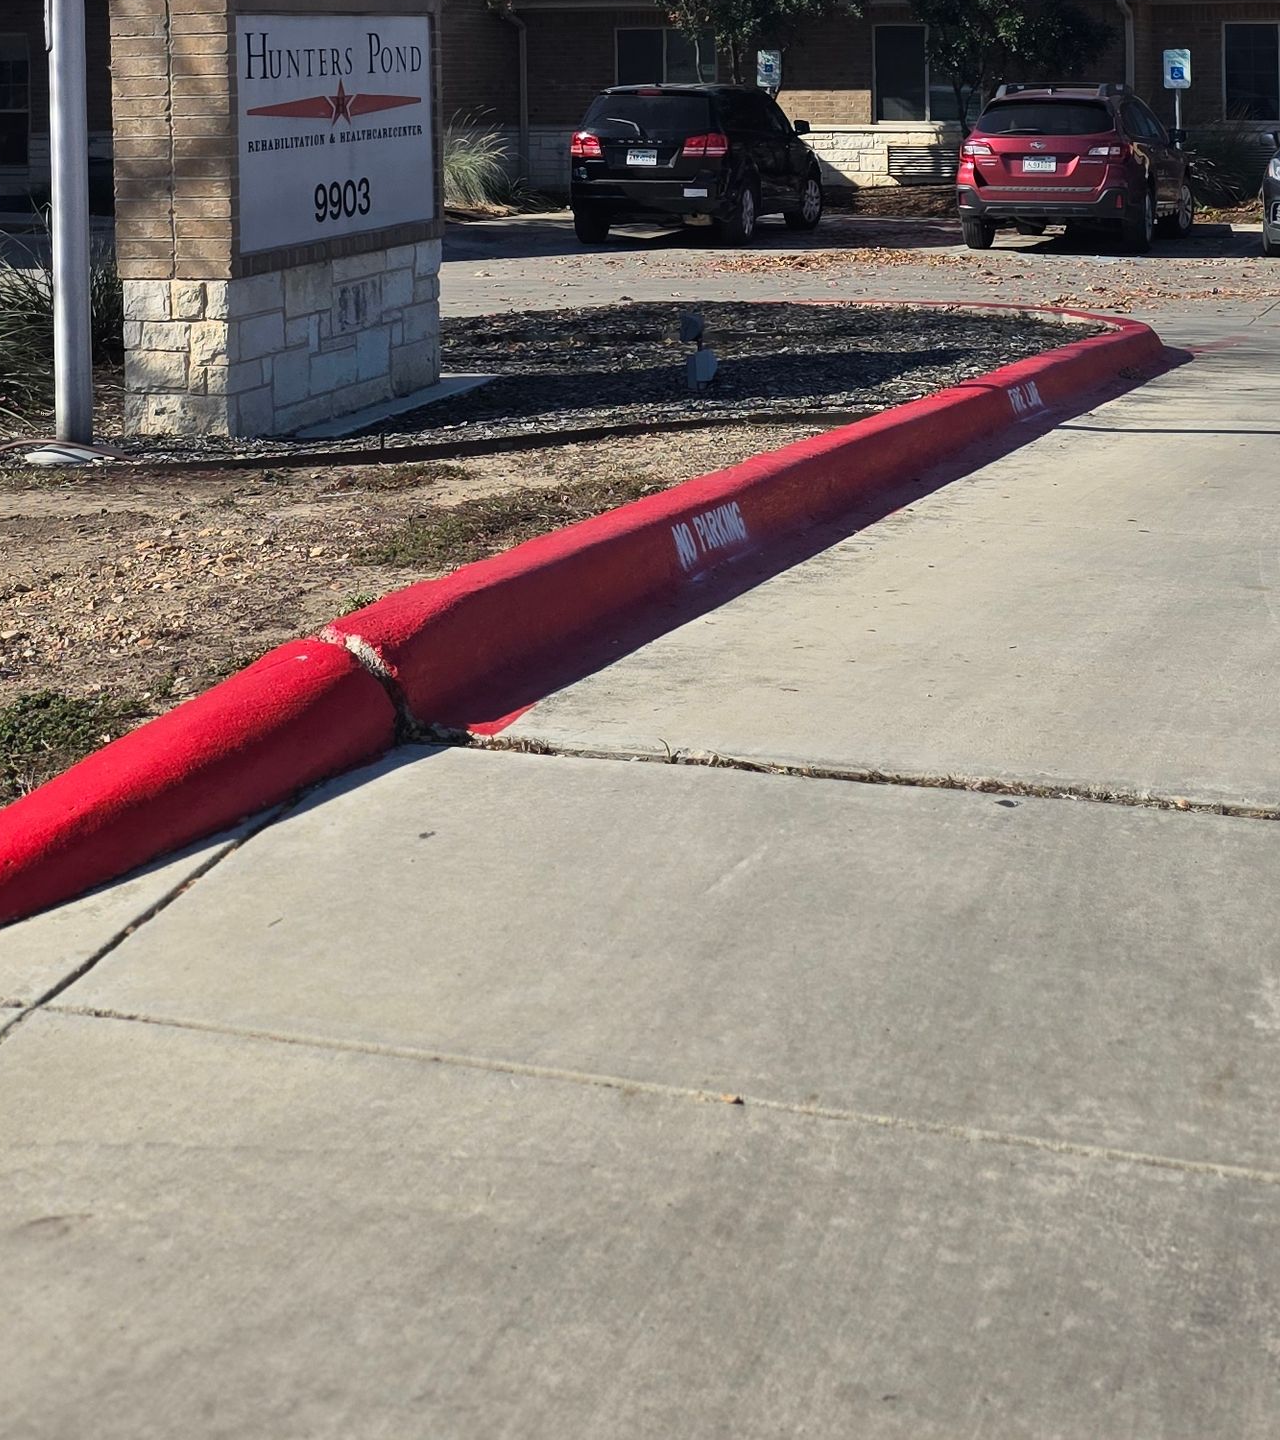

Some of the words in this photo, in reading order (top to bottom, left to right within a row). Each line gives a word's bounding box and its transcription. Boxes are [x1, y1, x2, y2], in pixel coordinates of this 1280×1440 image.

[244, 32, 353, 80] HUNTERS
[366, 32, 422, 74] POND
[247, 134, 326, 153] REHABILITATION
[329, 133, 336, 144] &
[313, 177, 371, 223] 9903
[671, 522, 698, 571] NO
[692, 501, 747, 553] PARKING
